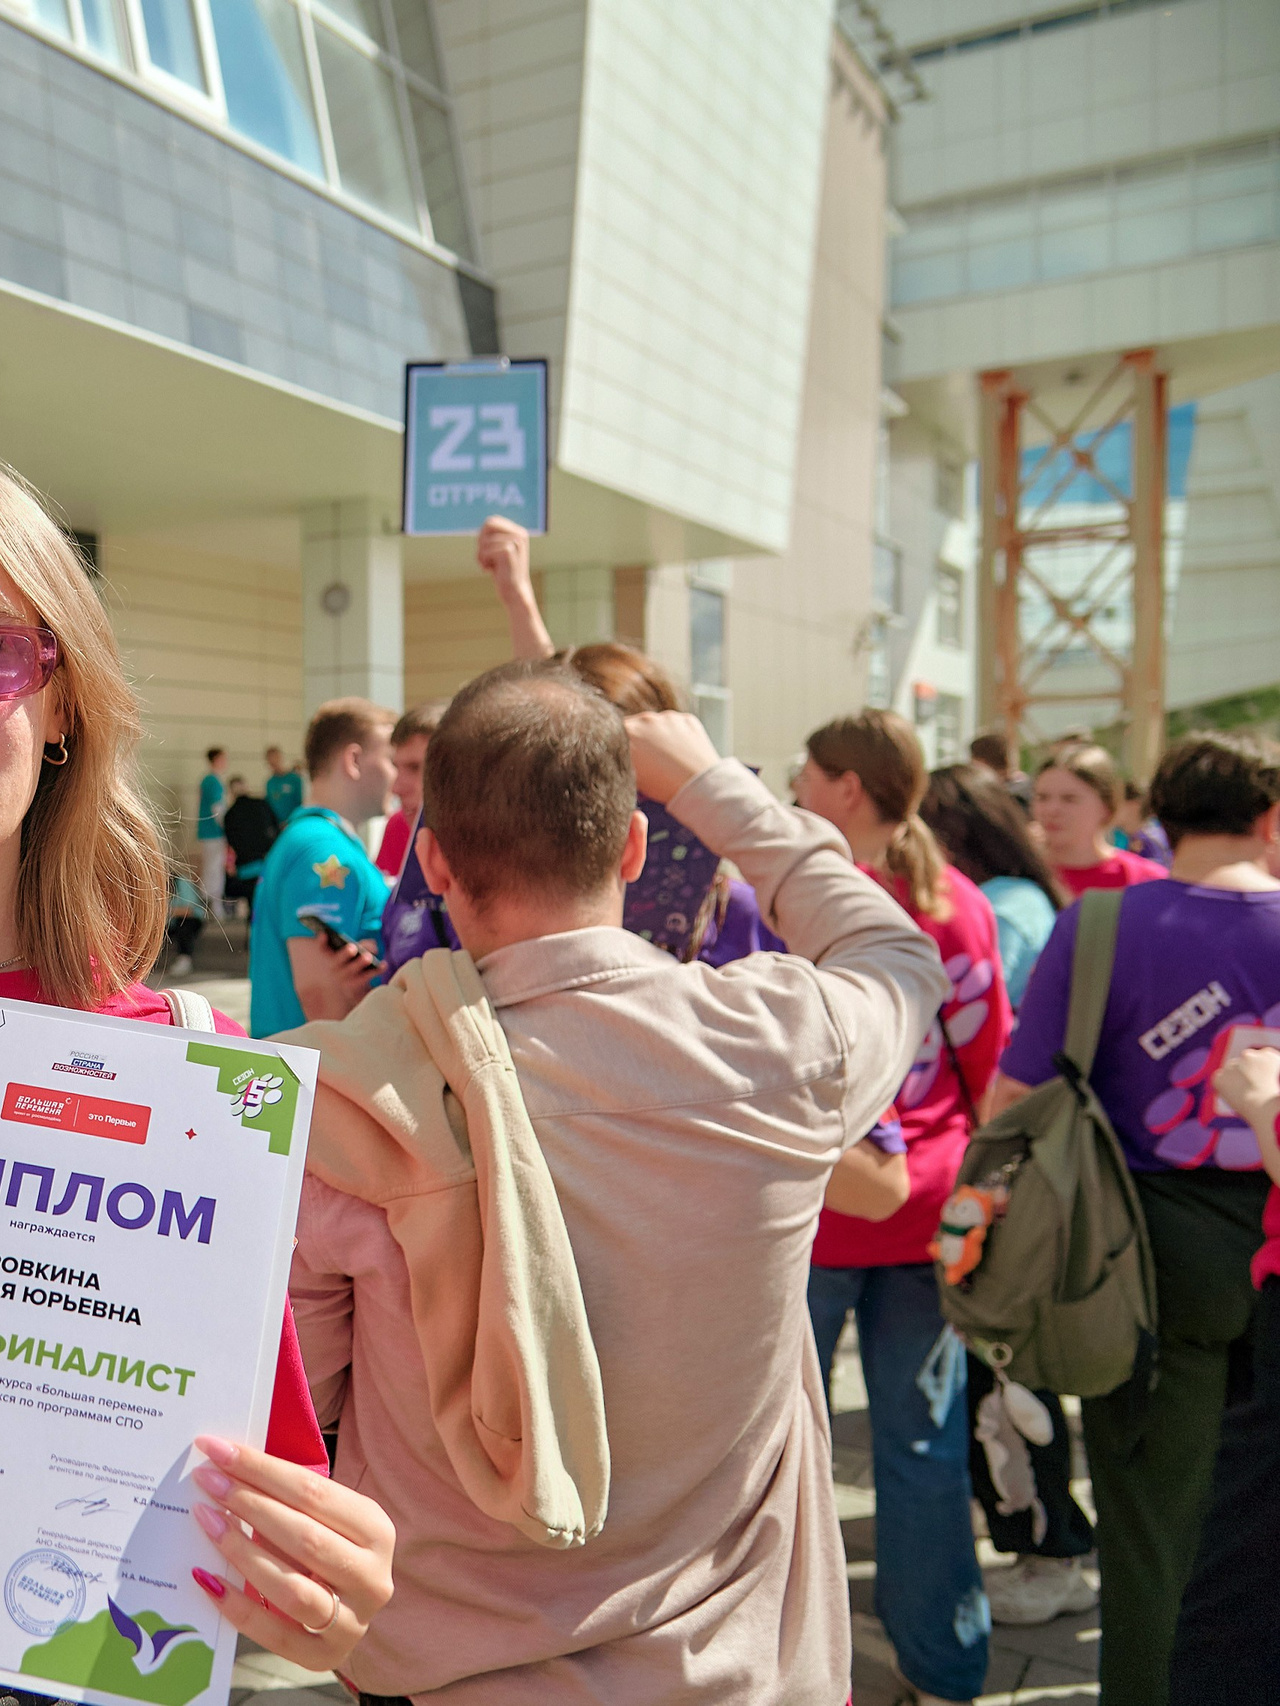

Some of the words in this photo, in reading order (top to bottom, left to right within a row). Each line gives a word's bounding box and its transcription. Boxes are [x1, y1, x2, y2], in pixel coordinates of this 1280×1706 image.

[429, 403, 525, 471] 23
[428, 481, 526, 508] ОТРЯД
[1138, 980, 1232, 1061] СЕЗОН
[70, 1050, 99, 1060] РОССИЯ
[72, 1060, 101, 1069] СТРАНА
[53, 1063, 113, 1079] ВОЗМОЖНОСТЕЙ
[232, 1068, 255, 1086] СЕЗОН
[17, 1095, 65, 1110] БОЛЬШАЯ
[244, 1079, 268, 1106] 5
[15, 1102, 62, 1115] ПЕРЕМЕНА
[88, 1113, 103, 1122] это
[104, 1114, 137, 1128] Первые
[9, 1219, 96, 1243] награждается
[22, 1286, 142, 1325] ЮРЬЕВНА
[35, 1382, 96, 1404] «Большая
[98, 1396, 164, 1419] перемена»
[19, 1395, 35, 1408] по
[37, 1400, 112, 1425] программам
[115, 1416, 144, 1431] СПО
[48, 1463, 84, 1477] агентства
[85, 1471, 94, 1479] по
[95, 1475, 118, 1485] делам
[50, 1453, 101, 1471] Руководитель
[102, 1464, 155, 1482] Федерального
[35, 1537, 53, 1547] АНО
[37, 1527, 86, 1544] Генеральный
[87, 1540, 122, 1553] директор
